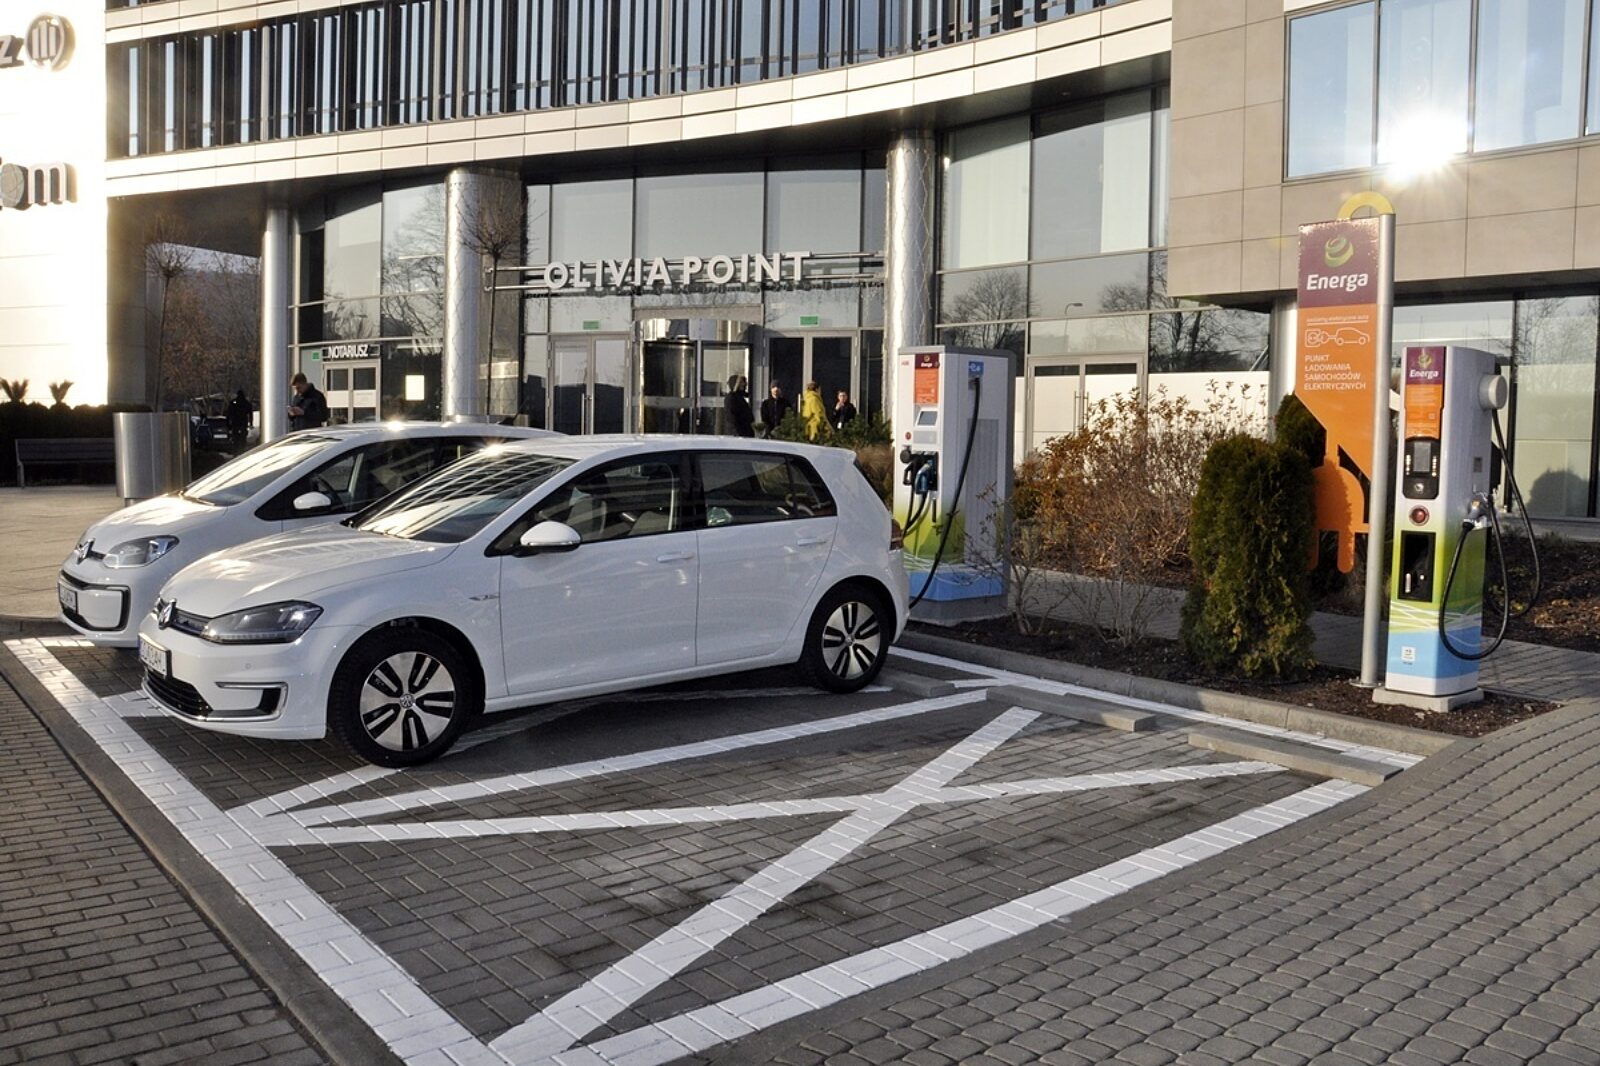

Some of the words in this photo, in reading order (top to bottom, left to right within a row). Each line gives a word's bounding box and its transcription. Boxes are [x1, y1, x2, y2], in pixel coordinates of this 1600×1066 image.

[544, 256, 673, 290] OLIVIA
[683, 251, 812, 285] POINT
[1306, 272, 1369, 292] Energa
[328, 343, 369, 359] NOTARIUSZ
[1304, 354, 1329, 363] PUNKT
[1409, 369, 1439, 379] Energa
[1303, 381, 1366, 391] ELEKTRYCZNYCH
